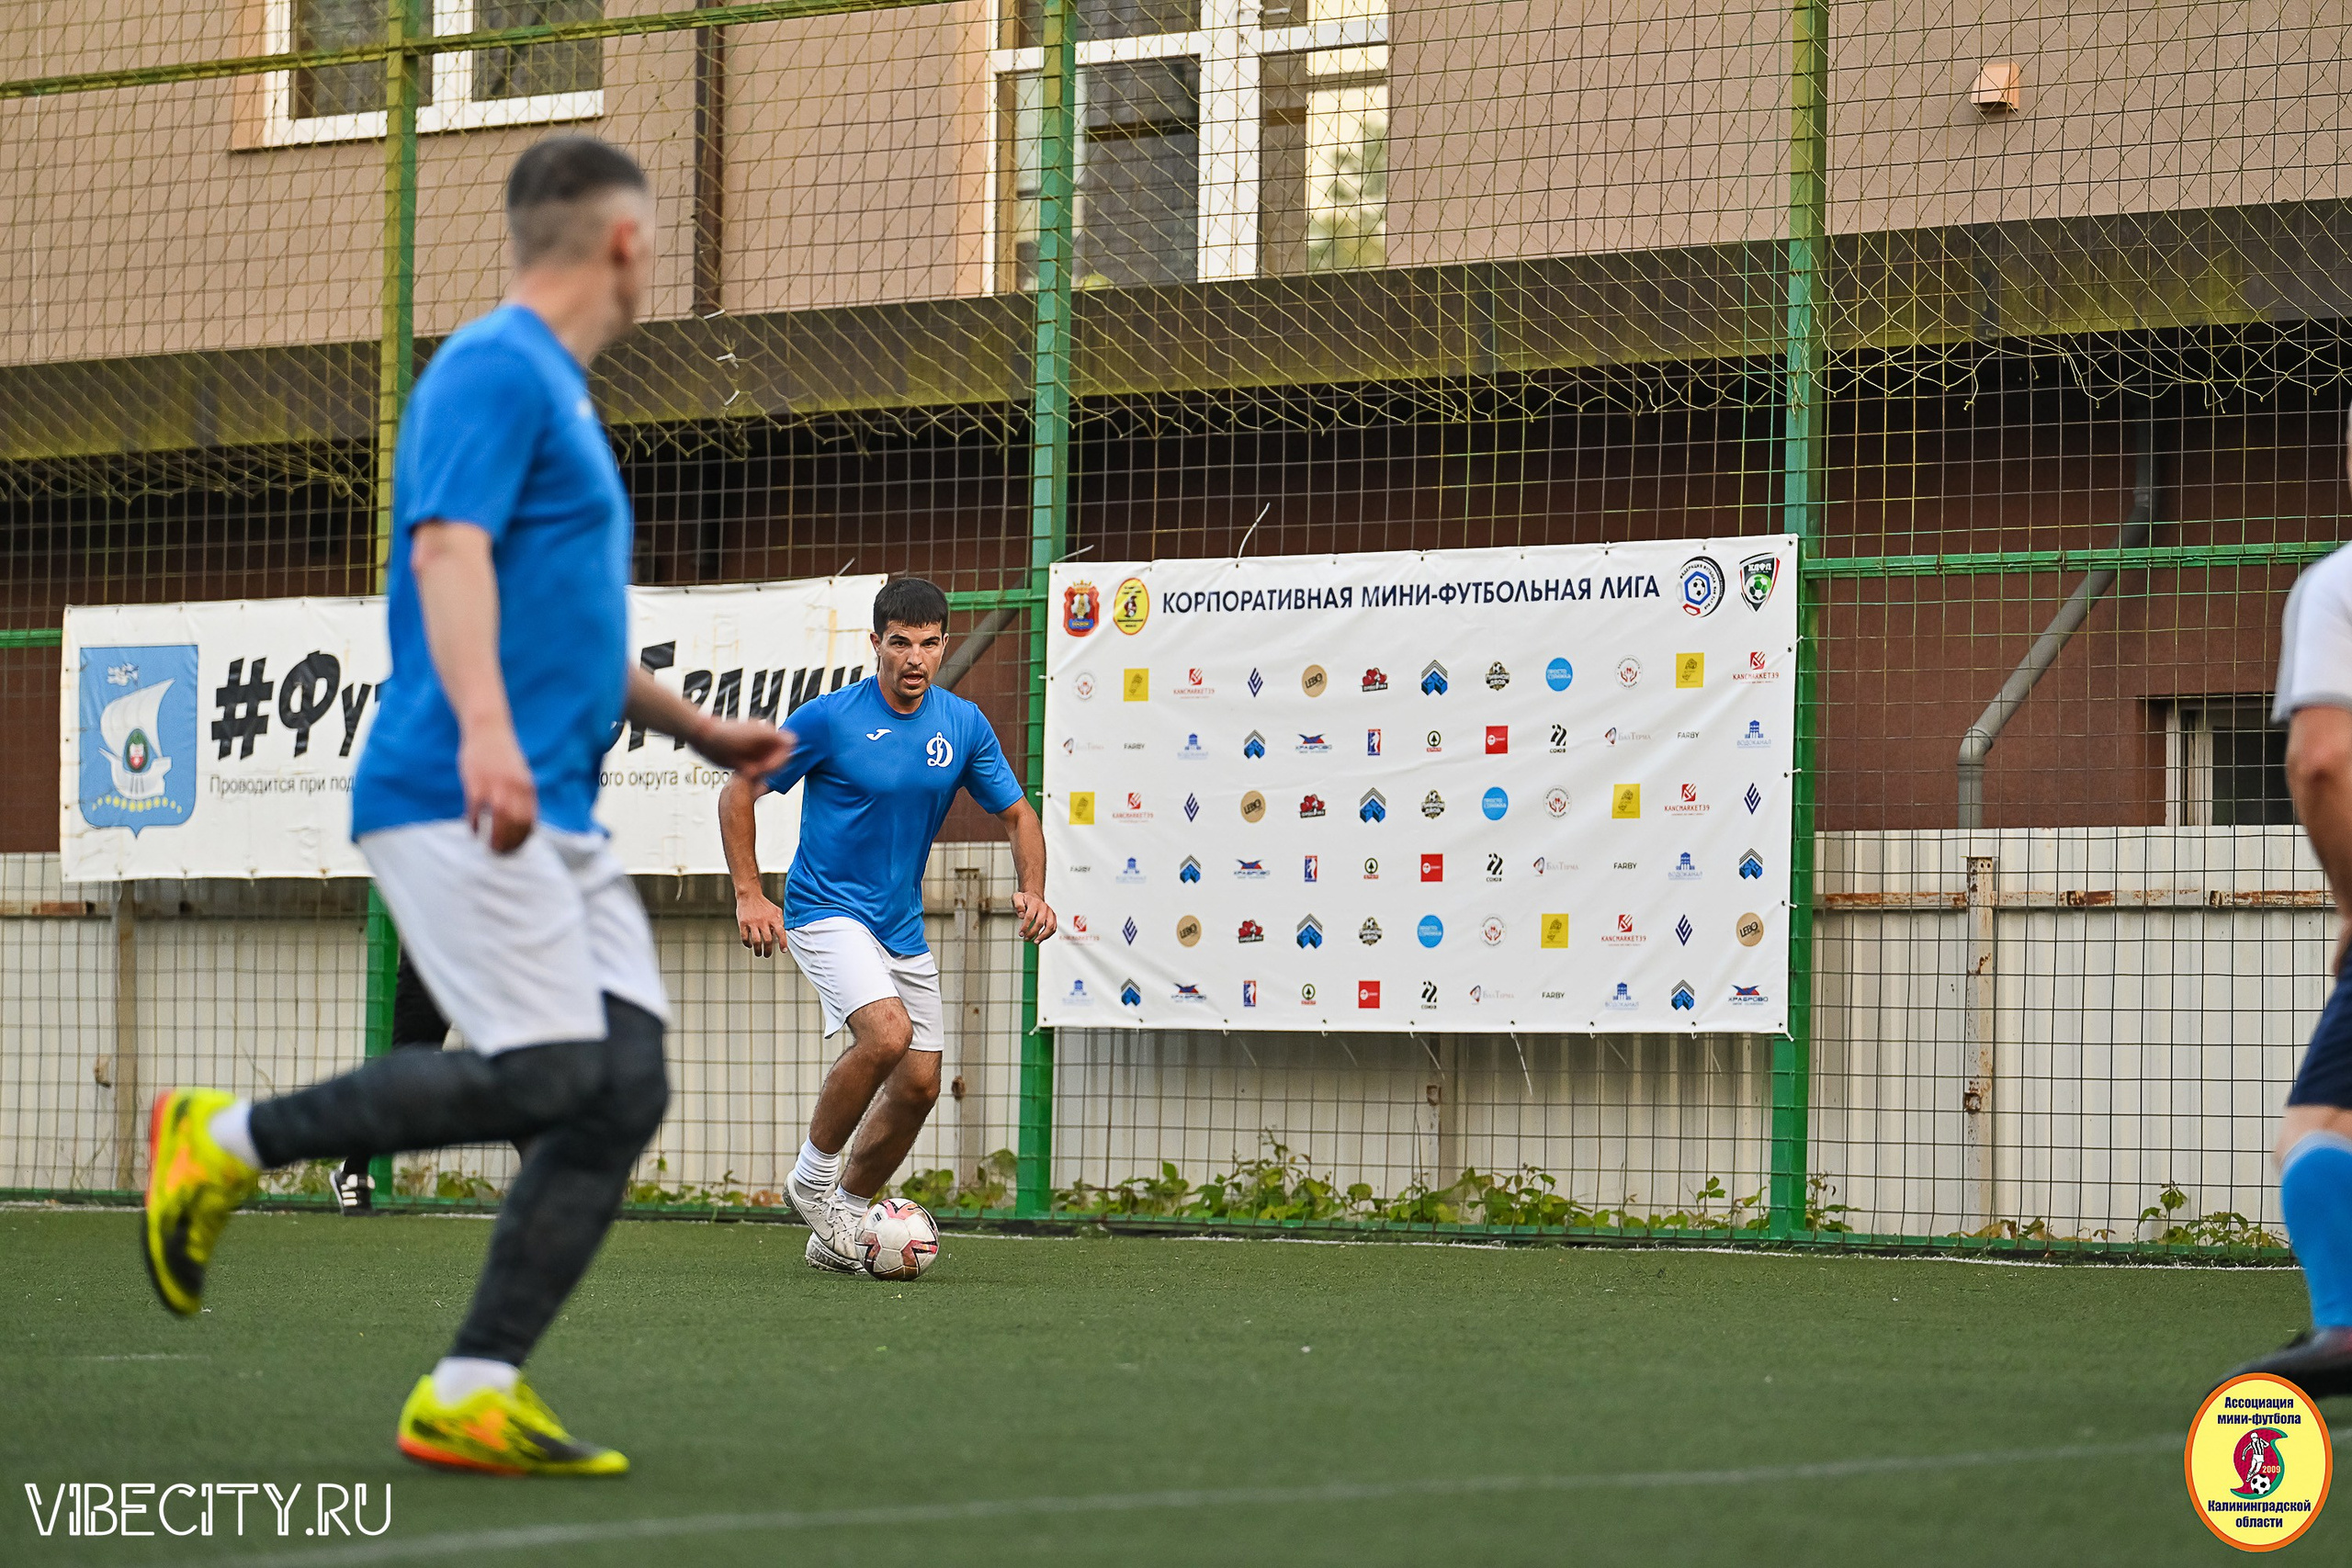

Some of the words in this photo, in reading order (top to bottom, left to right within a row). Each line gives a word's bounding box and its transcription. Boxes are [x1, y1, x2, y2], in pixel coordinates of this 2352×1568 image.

[1163, 587, 1352, 614] КОРПОРАТИВНАЯ
[1362, 577, 1591, 608] МИНИ-ФУТБОЛЬНАЯ
[1600, 575, 1660, 600] ЛИГА
[1677, 731, 1700, 739] FARBY
[209, 775, 295, 796] Проводится
[300, 778, 325, 796] при
[628, 771, 678, 790] округа
[1613, 862, 1637, 870] FARBY
[1739, 921, 1758, 938] LEBO
